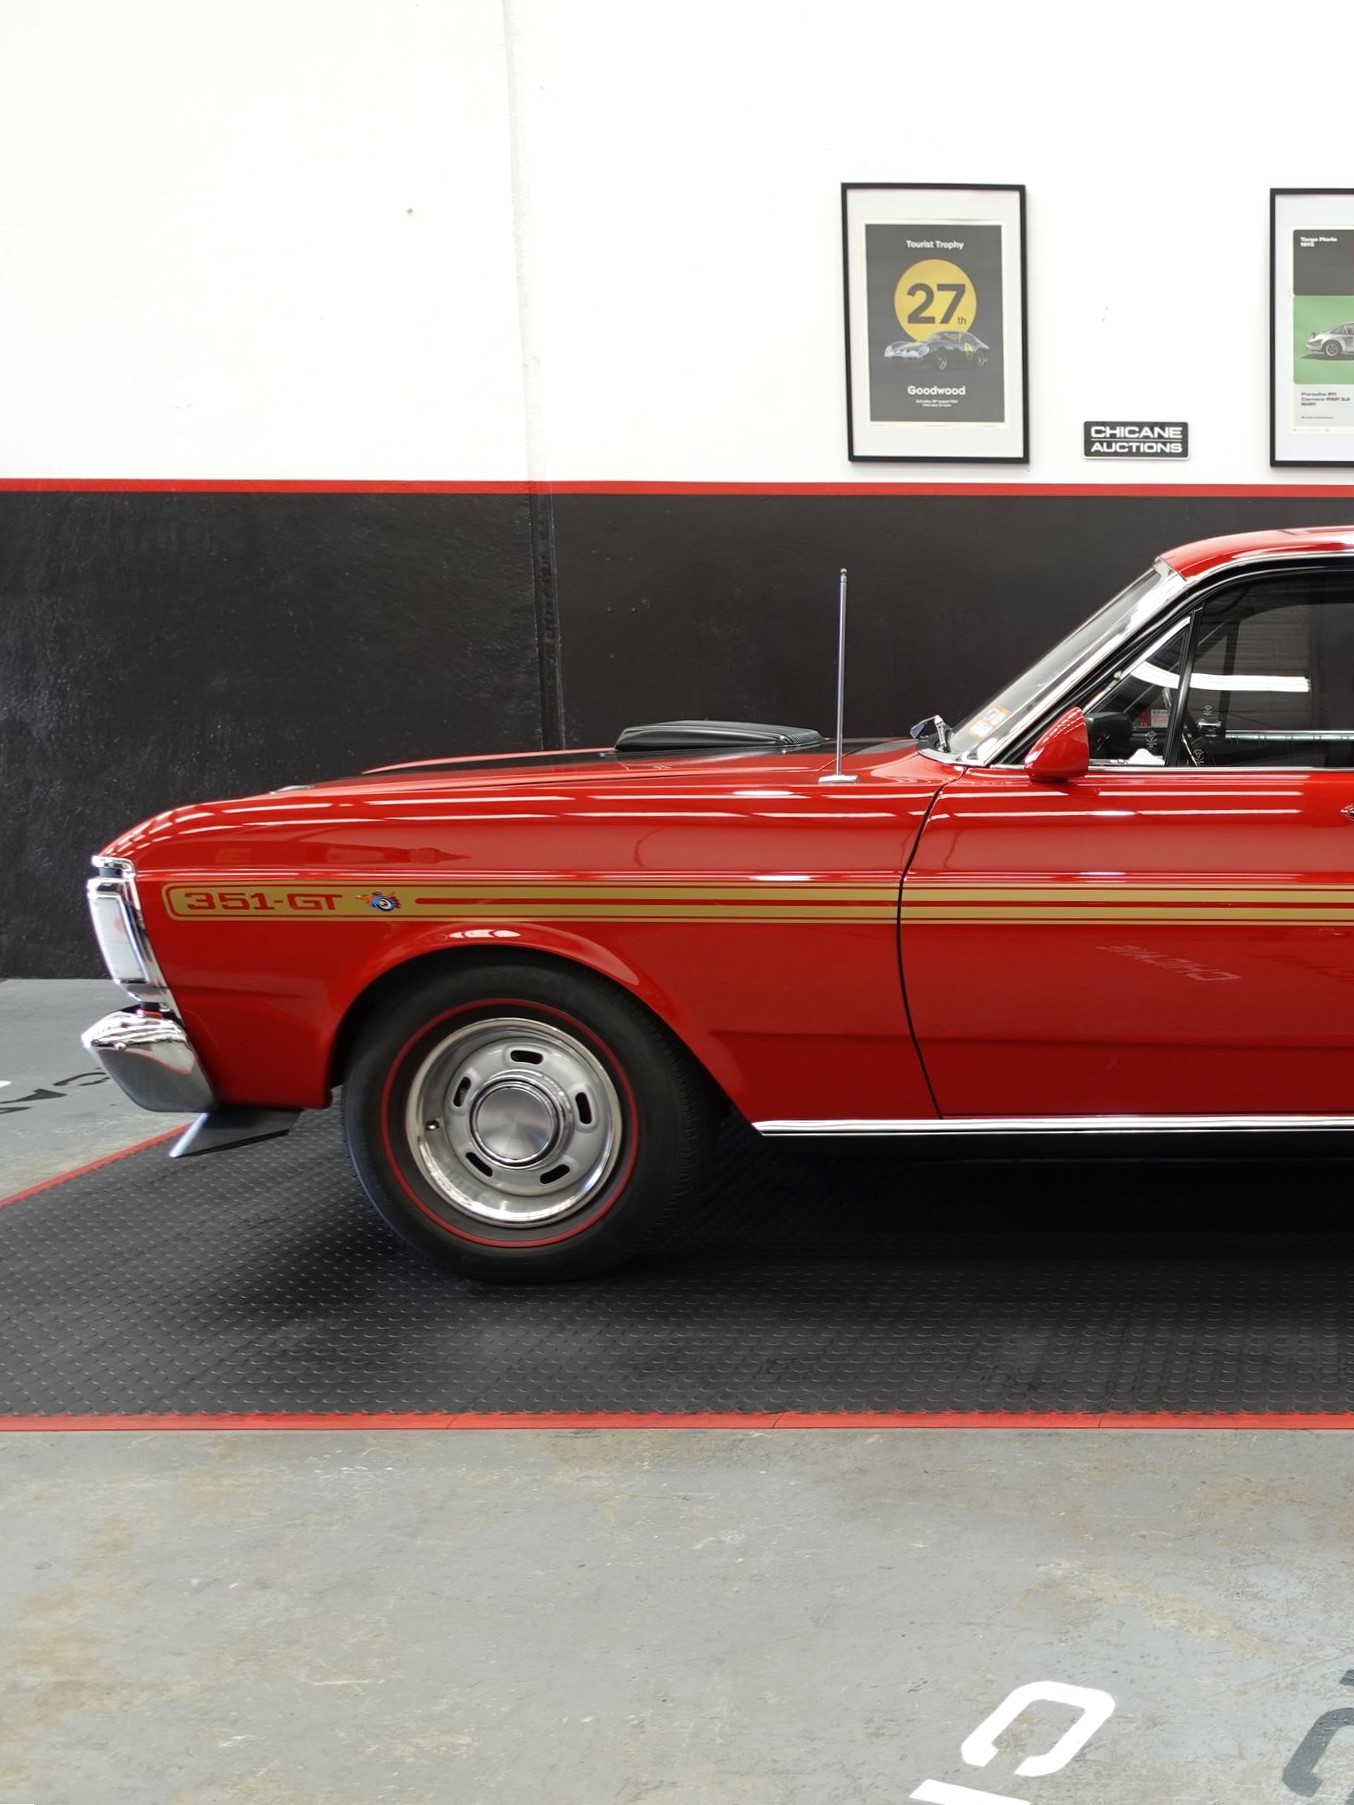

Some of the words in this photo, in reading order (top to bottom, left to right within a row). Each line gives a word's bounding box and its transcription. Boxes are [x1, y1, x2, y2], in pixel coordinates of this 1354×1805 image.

[906, 240, 934, 249] Tourist
[935, 240, 965, 250] Trophy
[907, 385, 966, 395] Goodwood
[1090, 426, 1183, 438] CHICANE
[1090, 442, 1183, 453] AUCTIONS
[183, 892, 343, 911] 351-GT
